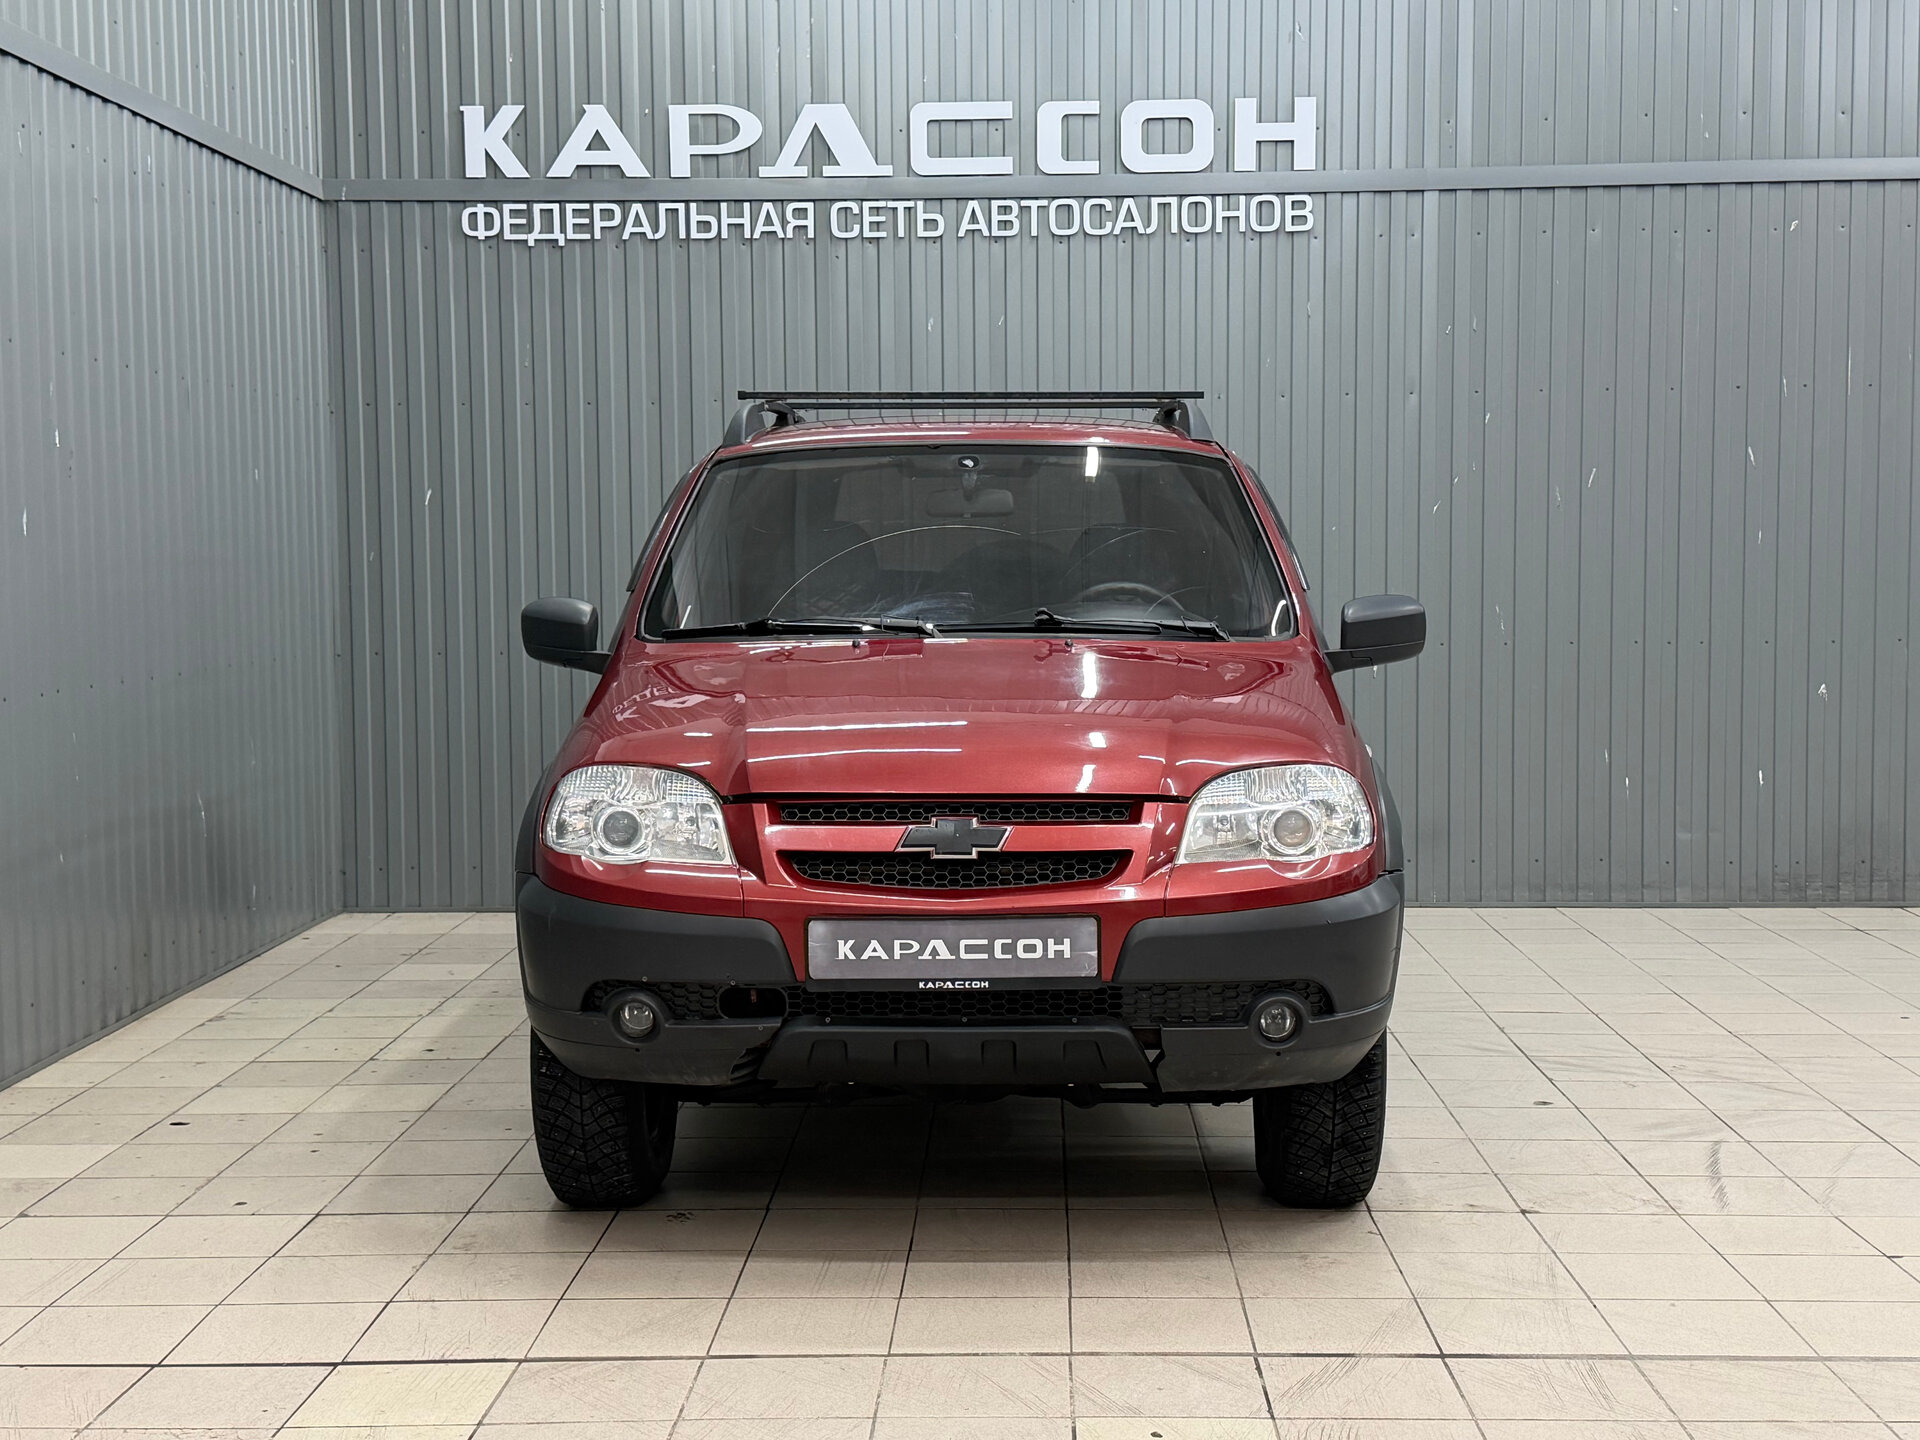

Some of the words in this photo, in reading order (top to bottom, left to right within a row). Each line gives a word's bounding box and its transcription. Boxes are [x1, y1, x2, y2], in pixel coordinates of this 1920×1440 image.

[459, 96, 1317, 178] КАРАССОН
[460, 200, 815, 247] ФЕДЕРАЛЬНАЯ
[829, 199, 945, 239] СЕТЬ
[957, 194, 1315, 239] АВТОСАЛОНОВ
[835, 937, 1071, 960] КАРАССОН
[918, 980, 989, 989] КАРАССОН
